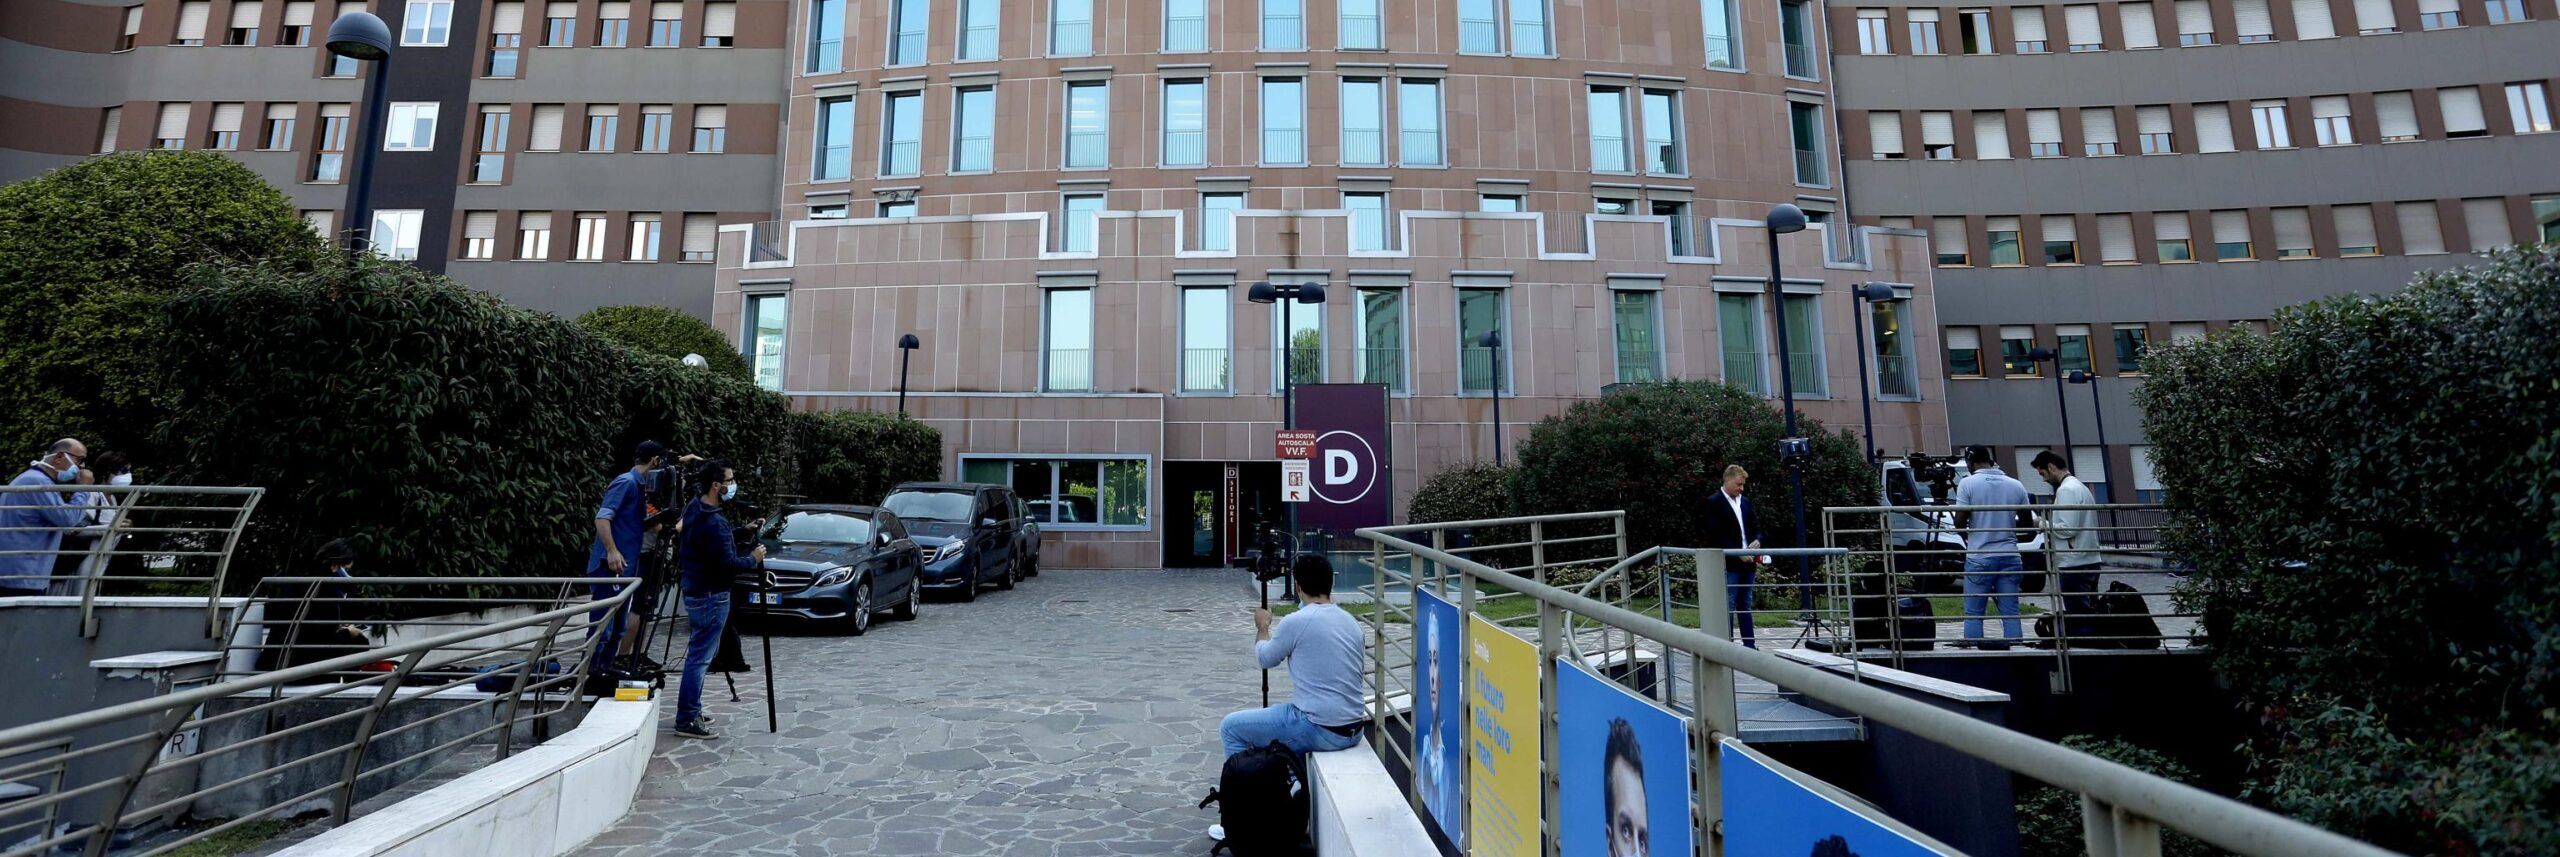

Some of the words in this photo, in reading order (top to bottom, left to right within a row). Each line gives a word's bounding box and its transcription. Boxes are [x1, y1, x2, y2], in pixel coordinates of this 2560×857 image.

[1285, 447, 1308, 456] VV.F.
[1324, 449, 1358, 485] D
[1228, 469, 1236, 477] D
[1480, 670, 1504, 713] futuro
[1475, 705, 1492, 738] nelle
[1493, 714, 1511, 754] loro
